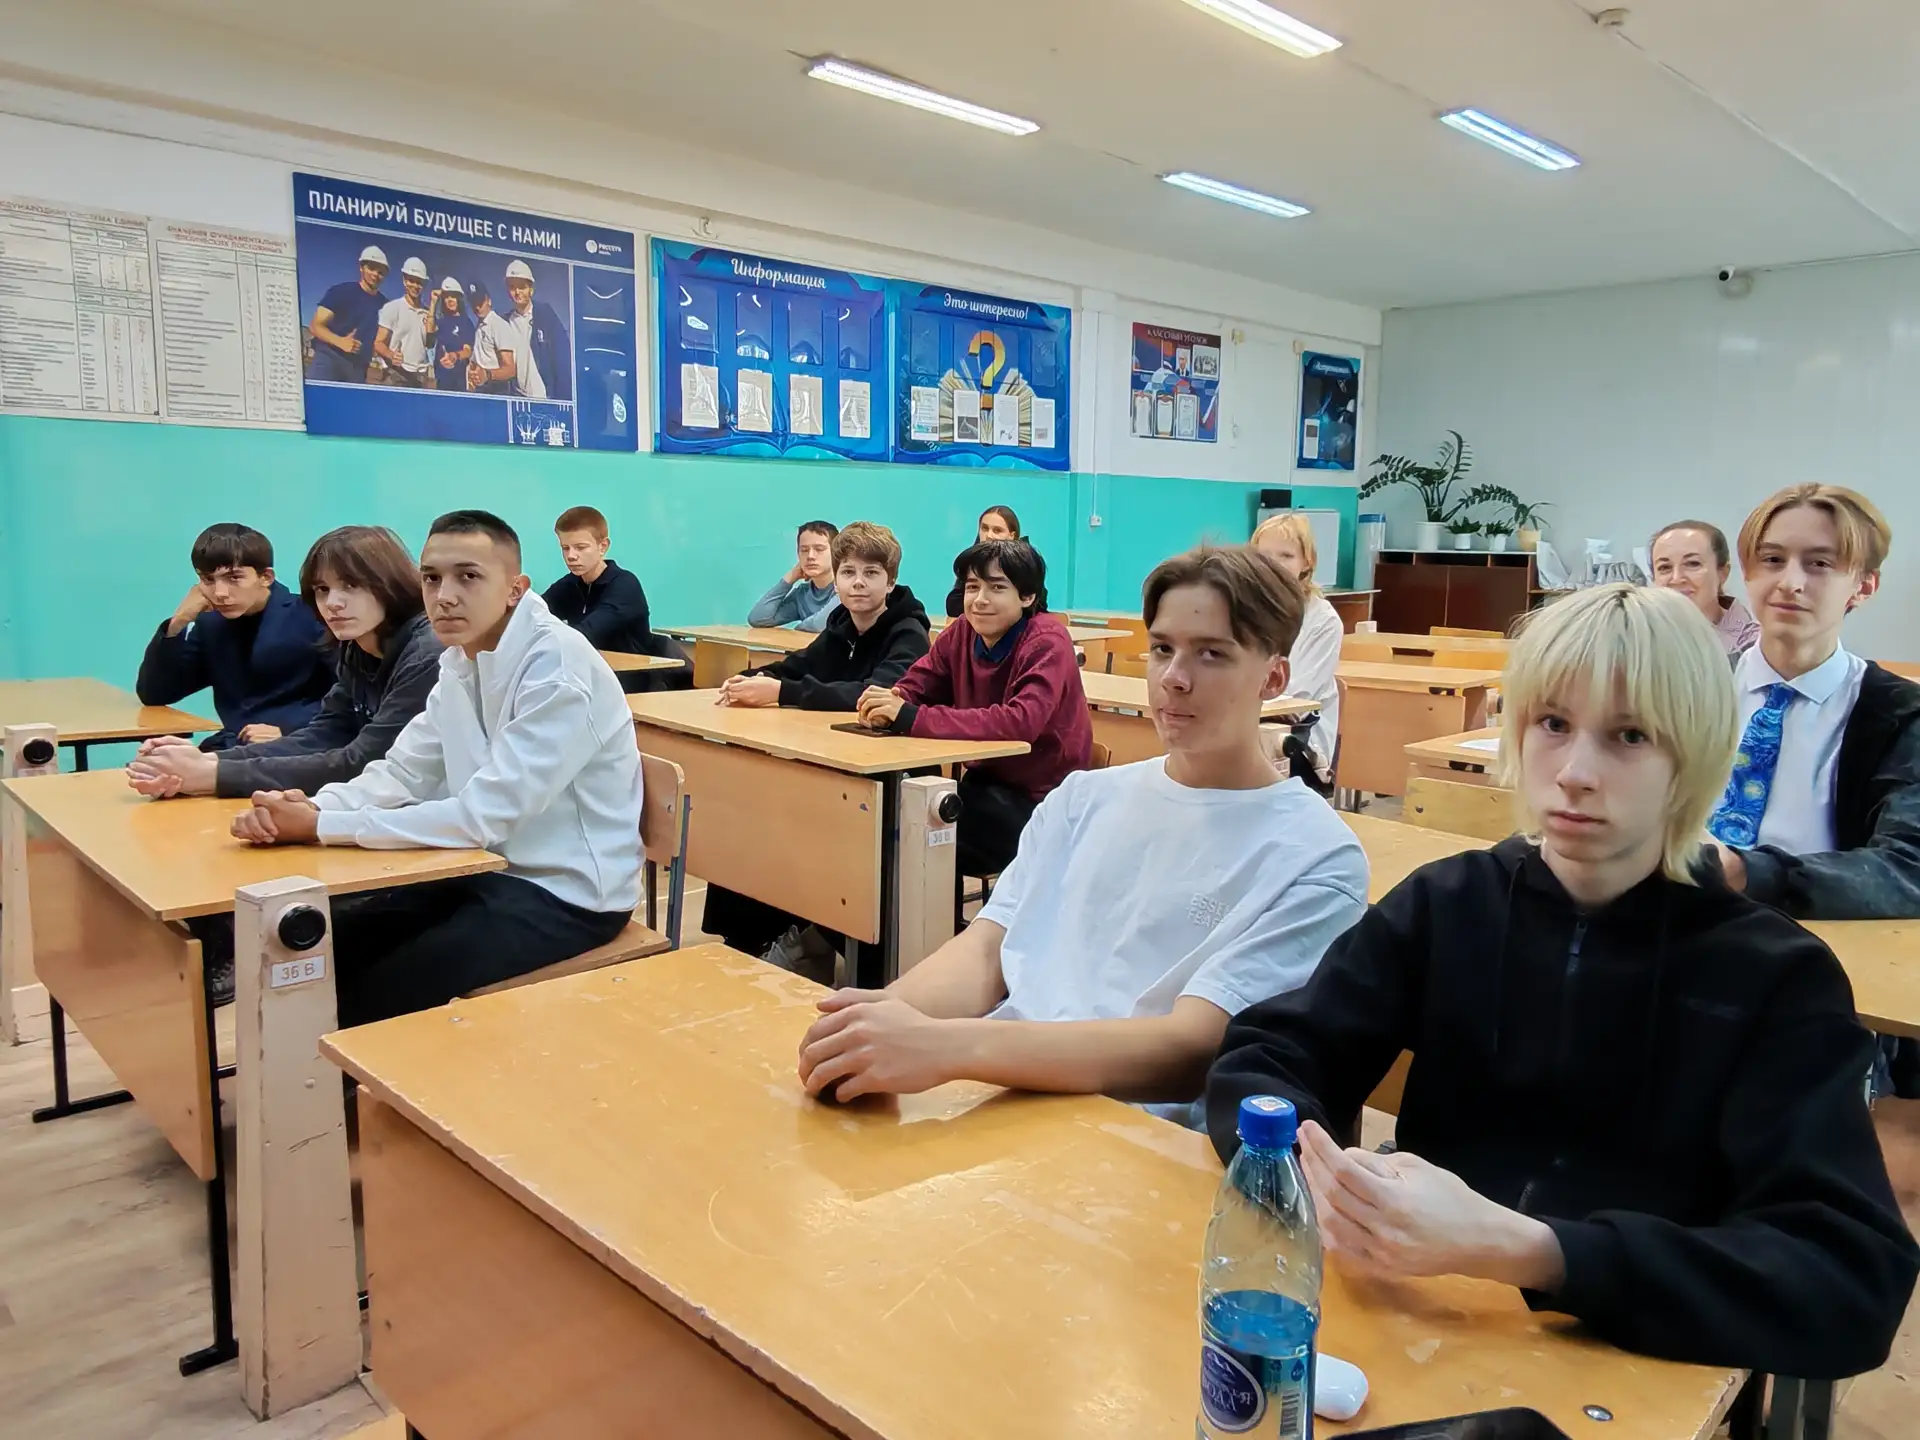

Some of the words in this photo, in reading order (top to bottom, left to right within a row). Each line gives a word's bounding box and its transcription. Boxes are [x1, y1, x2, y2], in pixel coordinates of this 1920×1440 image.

[308, 190, 408, 224] ПЛАНИРУЙ
[414, 208, 493, 239] БУДУЩЕЕ
[498, 223, 507, 240] С
[512, 226, 561, 250] НАМИ!
[731, 258, 827, 290] Информация
[943, 292, 969, 310] Это
[970, 300, 1029, 322] интересно!
[281, 965, 301, 981] 36
